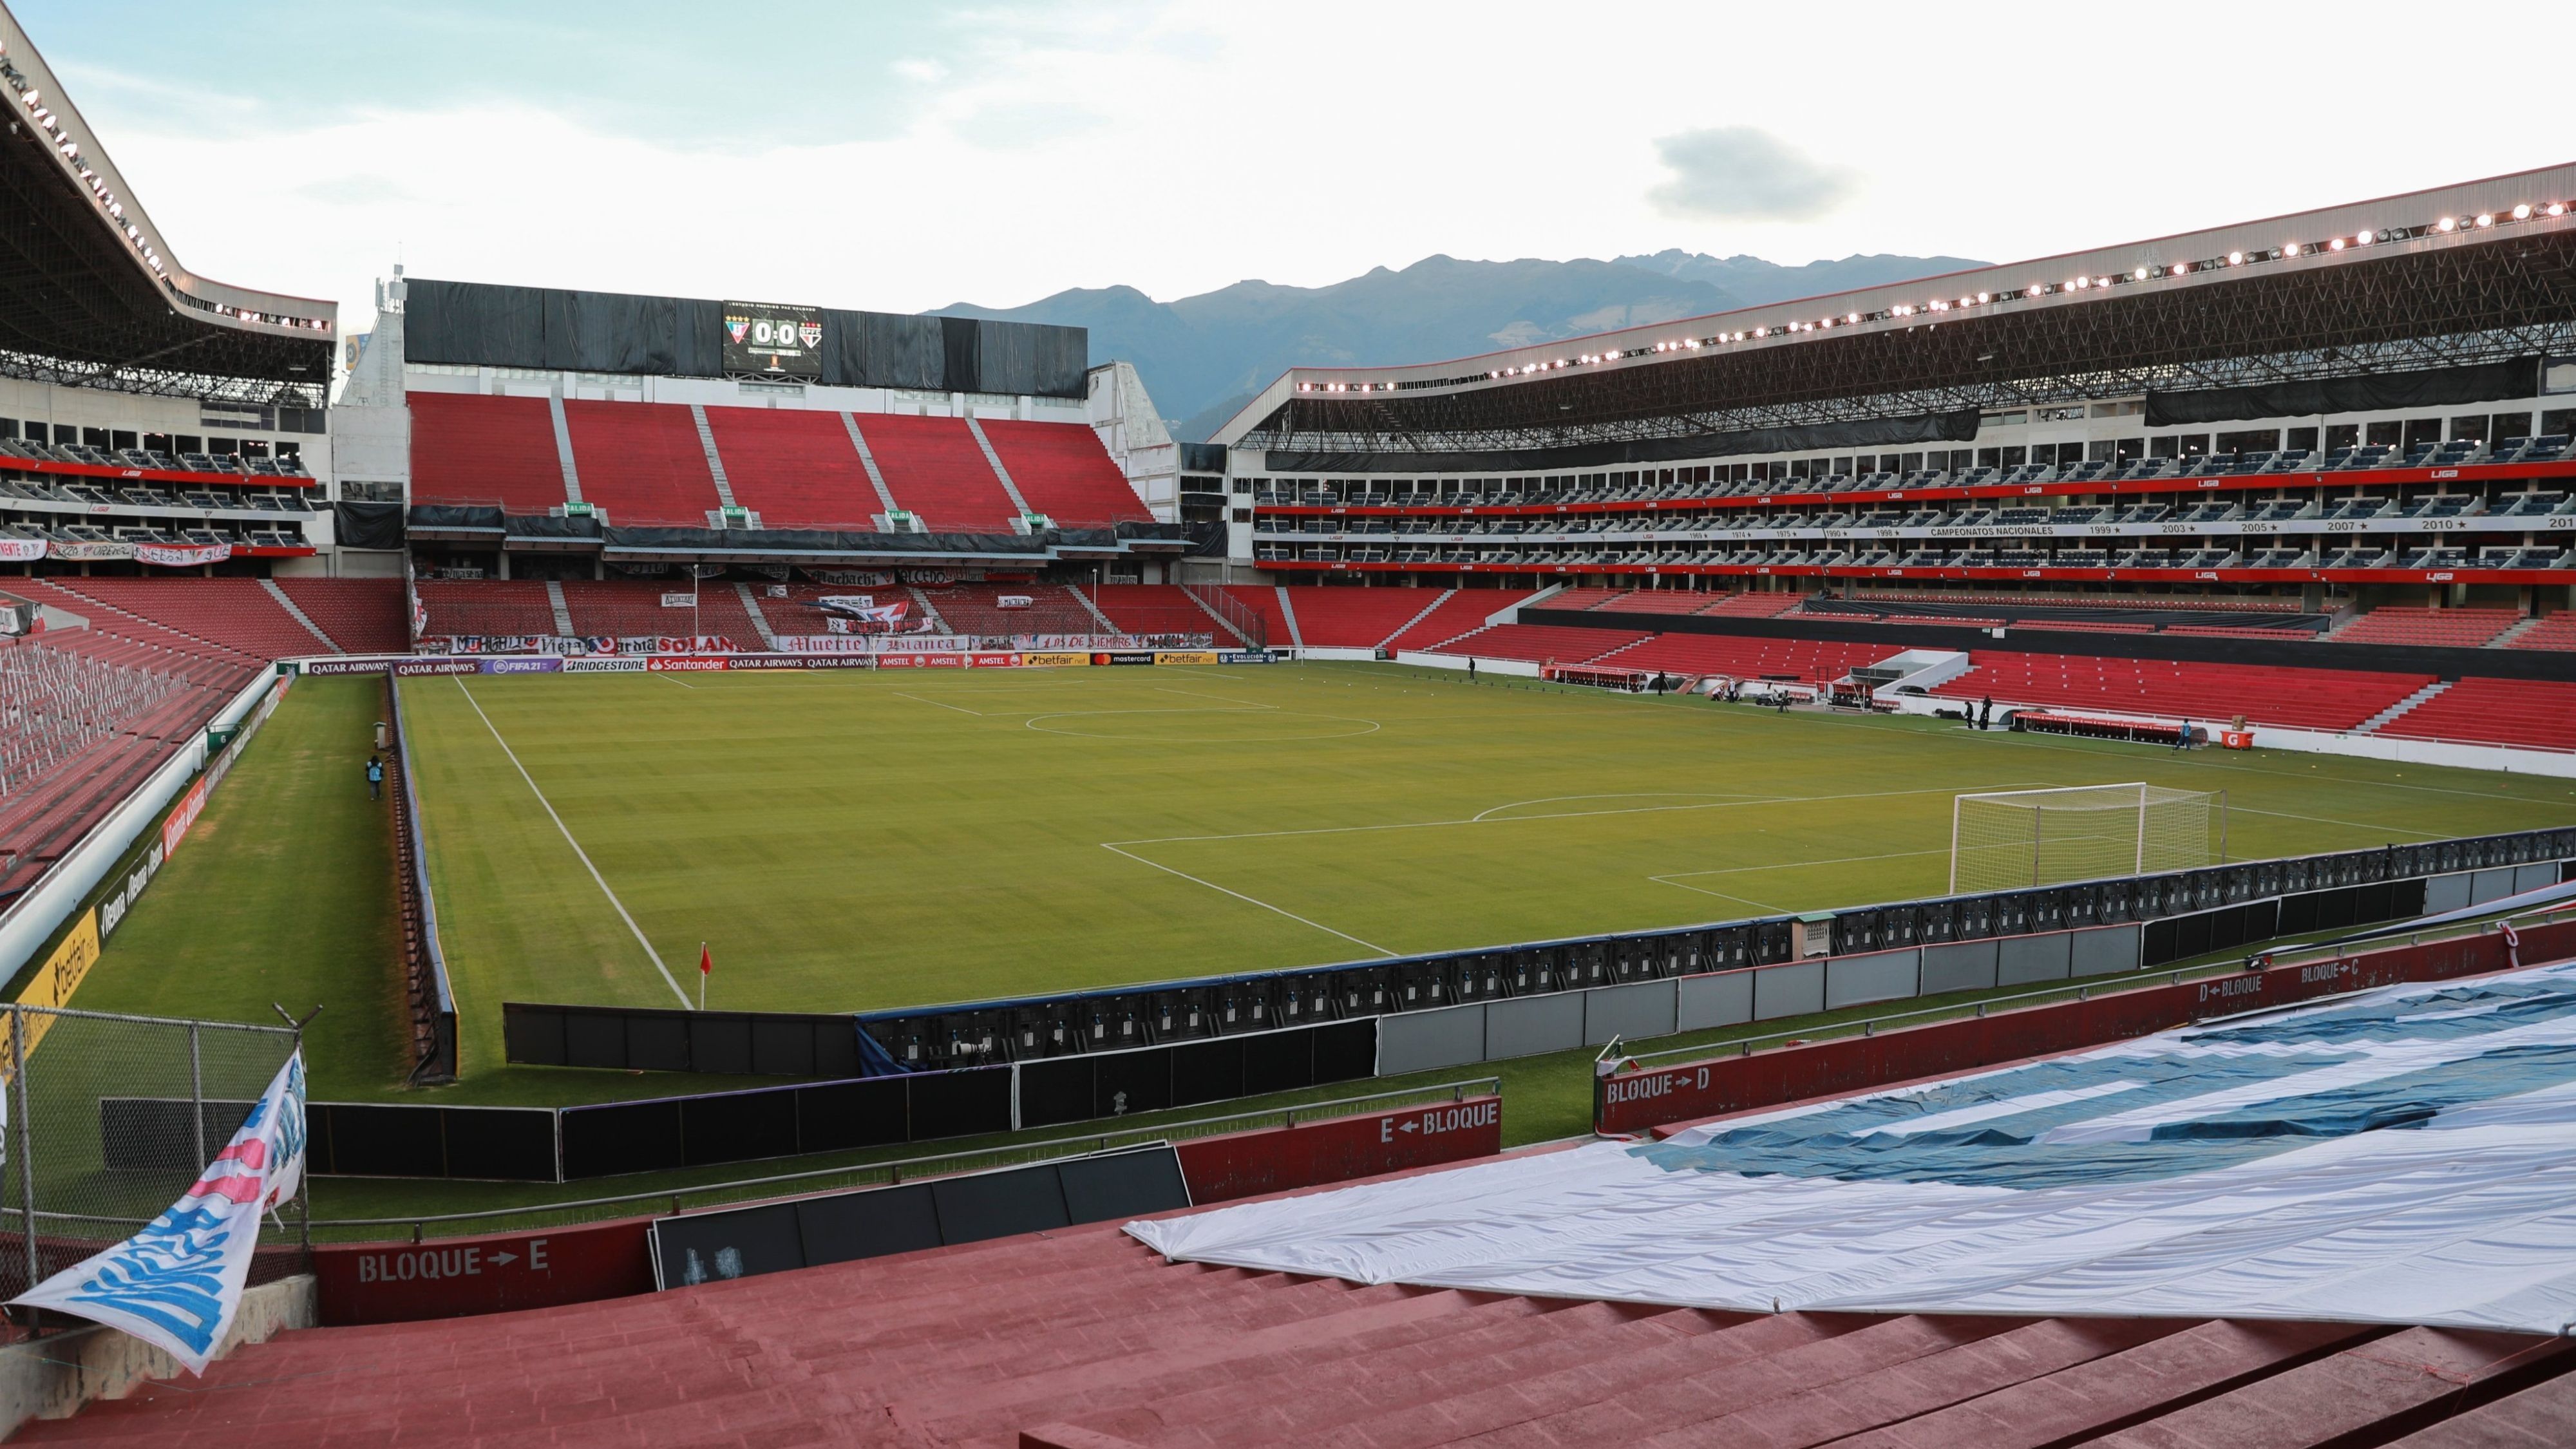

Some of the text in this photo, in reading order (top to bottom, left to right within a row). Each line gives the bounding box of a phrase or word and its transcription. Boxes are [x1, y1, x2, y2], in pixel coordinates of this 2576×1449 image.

[1931, 528, 1994, 536] CAMPEONATOS
[1996, 527, 2054, 535] NACIONALES
[2162, 525, 2186, 533] 2003
[2241, 524, 2267, 533] 2005
[2327, 522, 2354, 531] 2007
[2422, 520, 2453, 529] 2010
[312, 663, 346, 674] QATAR
[399, 662, 475, 676] QATAR AIRWAYS
[567, 660, 645, 670] BRIDGESTONE
[664, 659, 724, 670] Santander
[730, 659, 802, 668] QATAR AIRWAYS
[808, 658, 878, 667] QATAR AIRWAYS
[220, 735, 226, 743] 6
[2228, 734, 2238, 745] G
[169, 812, 186, 853] Santander
[149, 842, 164, 876] Rexona
[128, 865, 147, 904] Rexona
[102, 891, 126, 936] Rexona
[2302, 958, 2358, 983] BLOQUE C
[2199, 976, 2262, 1002] D BLOQUE
[1607, 1068, 1709, 1104] BLOQUE D
[1381, 1103, 1497, 1142] E BLOQUE
[359, 1239, 548, 1283] BLOQUE E
